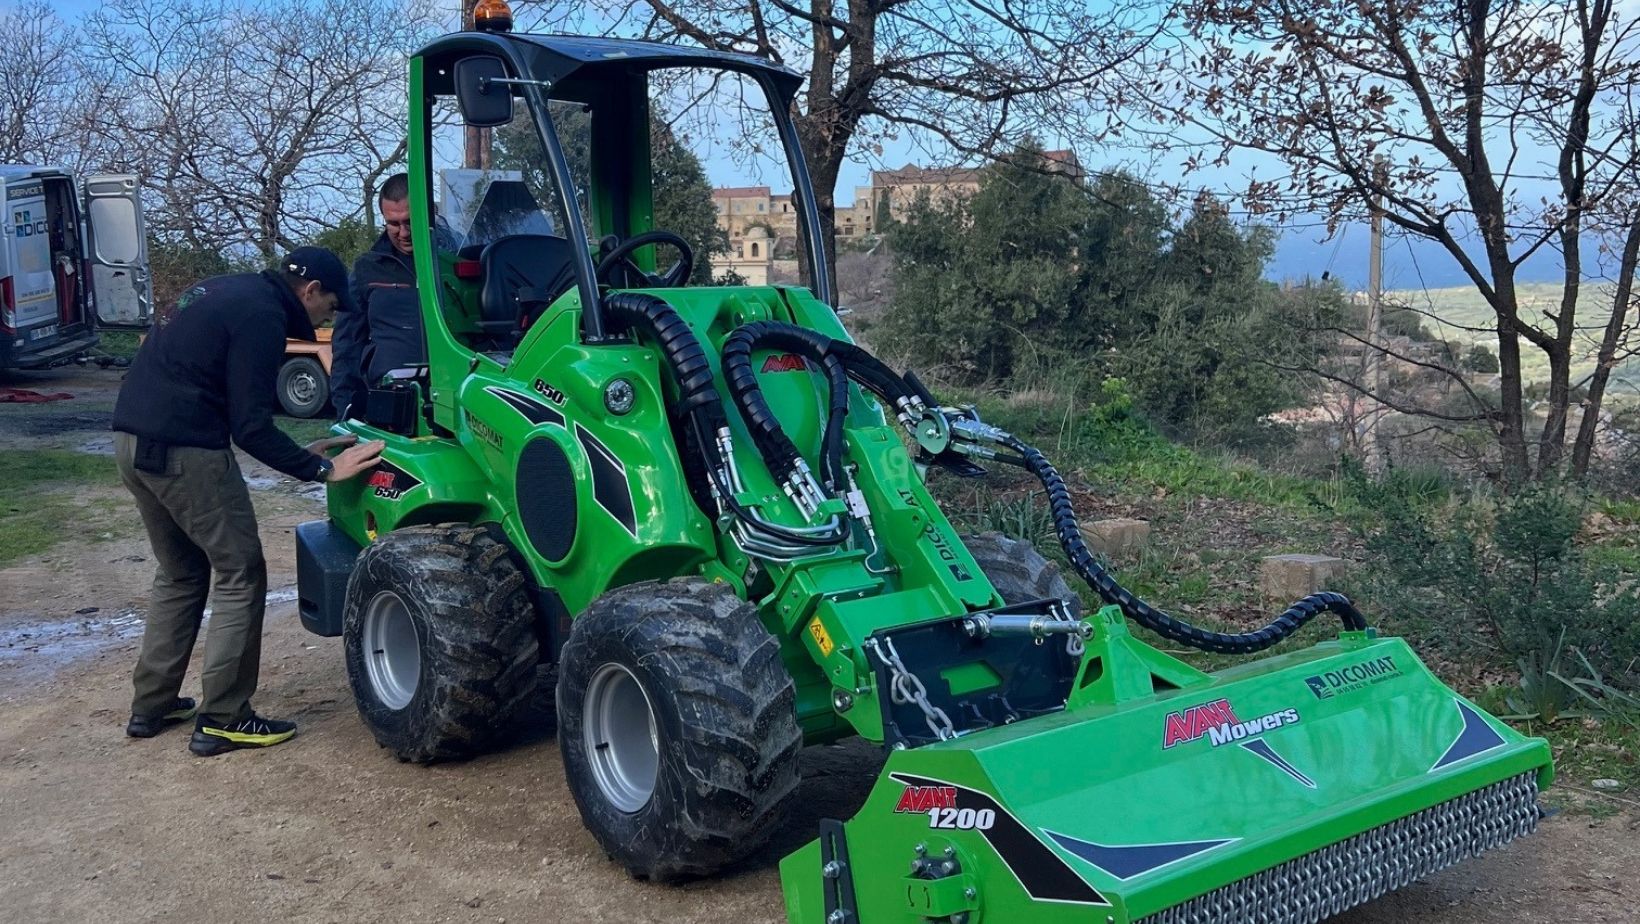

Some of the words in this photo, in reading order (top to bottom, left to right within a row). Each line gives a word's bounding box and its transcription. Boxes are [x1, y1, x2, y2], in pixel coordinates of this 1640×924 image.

[897, 488, 954, 561] DICOAT
[1324, 656, 1397, 688] DICOMAT
[1163, 698, 1240, 749] AVANT
[1208, 707, 1299, 747] Mowers
[894, 785, 957, 813] AVANT
[928, 807, 996, 830] 1200
